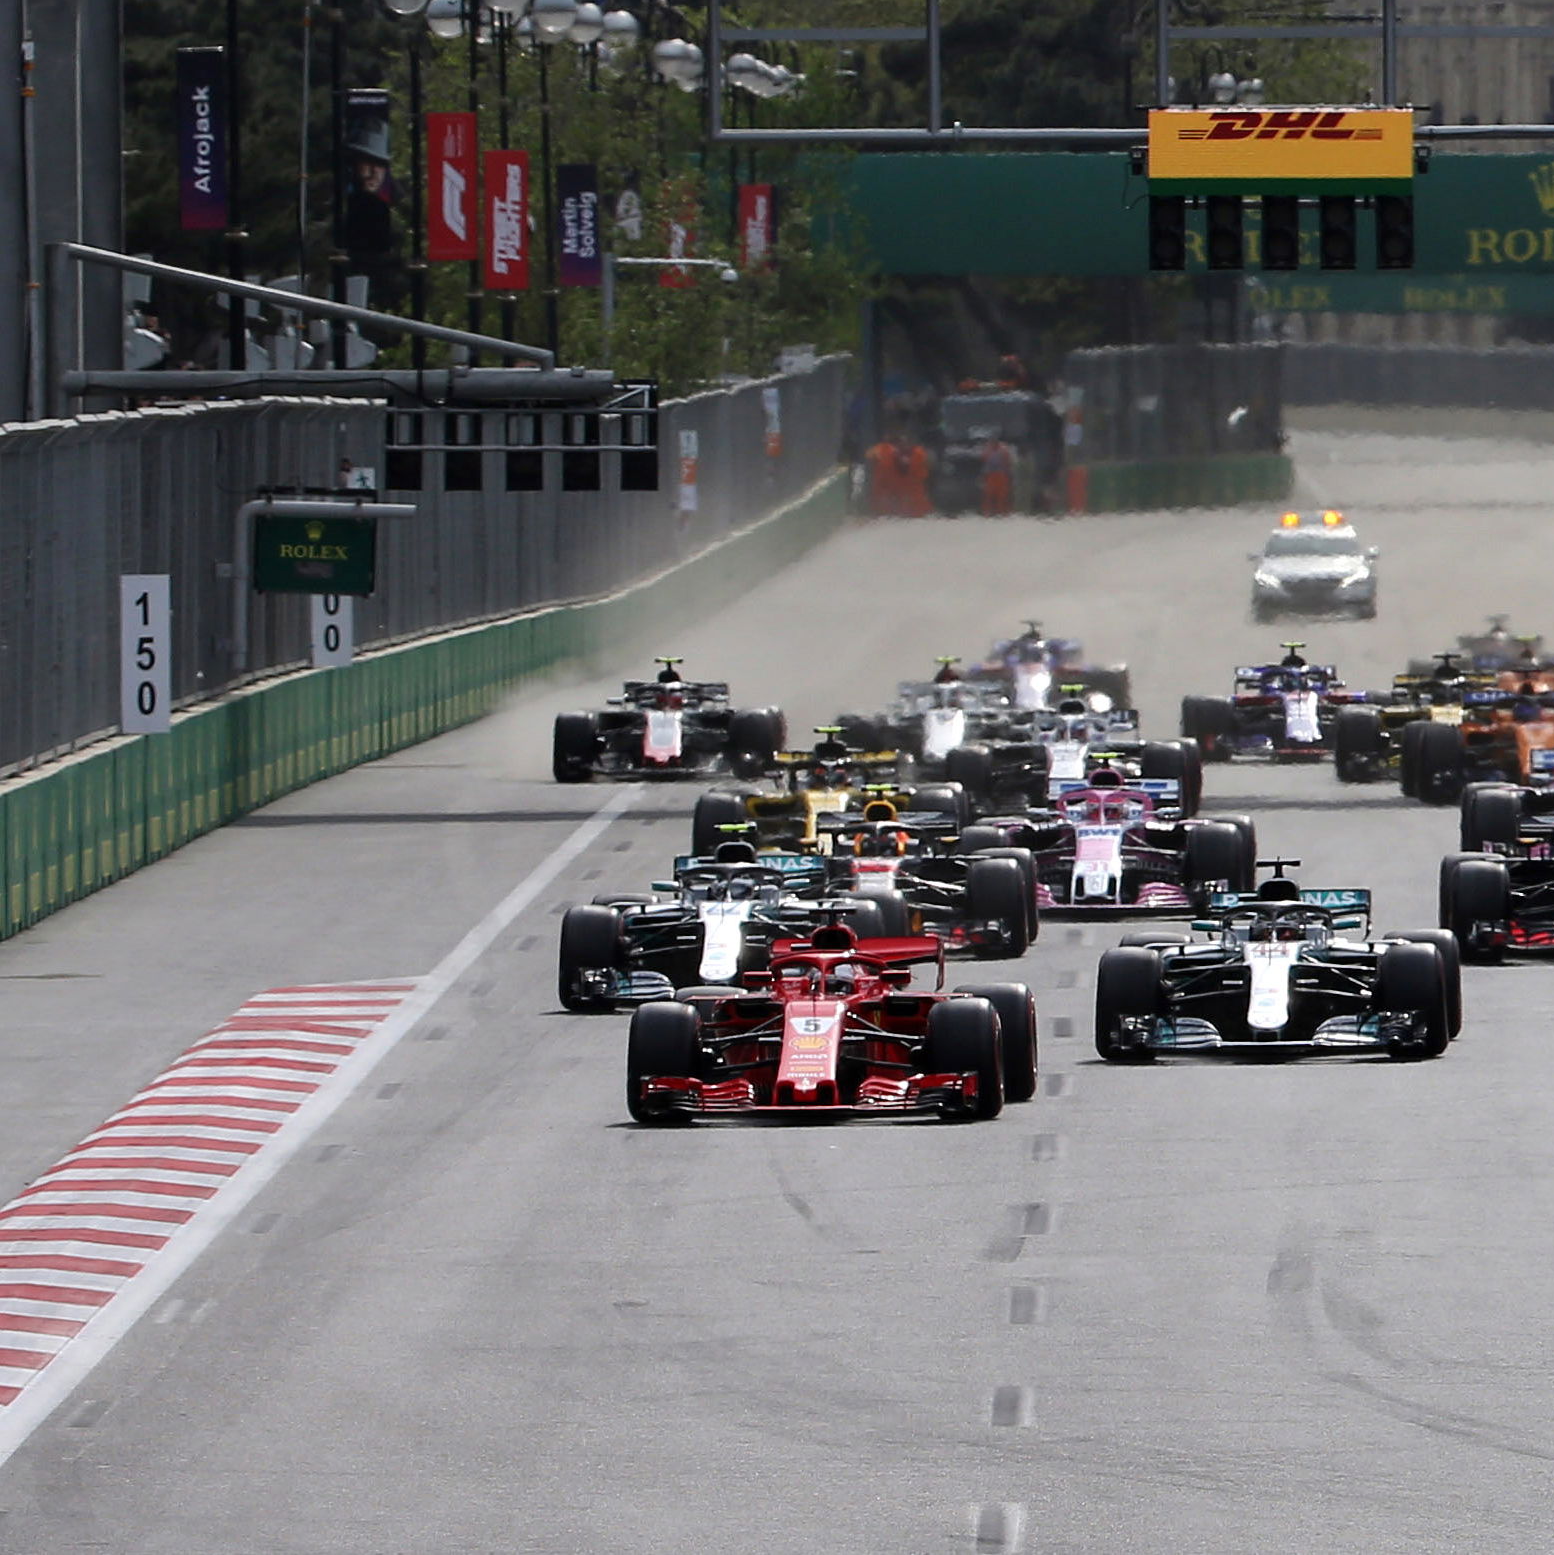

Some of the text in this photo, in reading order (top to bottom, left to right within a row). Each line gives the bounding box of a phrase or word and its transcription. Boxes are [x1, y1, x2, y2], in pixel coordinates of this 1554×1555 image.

[192, 86, 215, 194] Afrojack
[1206, 112, 1355, 140] DHL
[561, 197, 577, 254] Martin
[579, 191, 597, 258] Solveig
[279, 544, 348, 560] ROLEX
[323, 595, 340, 652] 00
[135, 592, 156, 715] 150
[803, 1019, 821, 1033] 5
